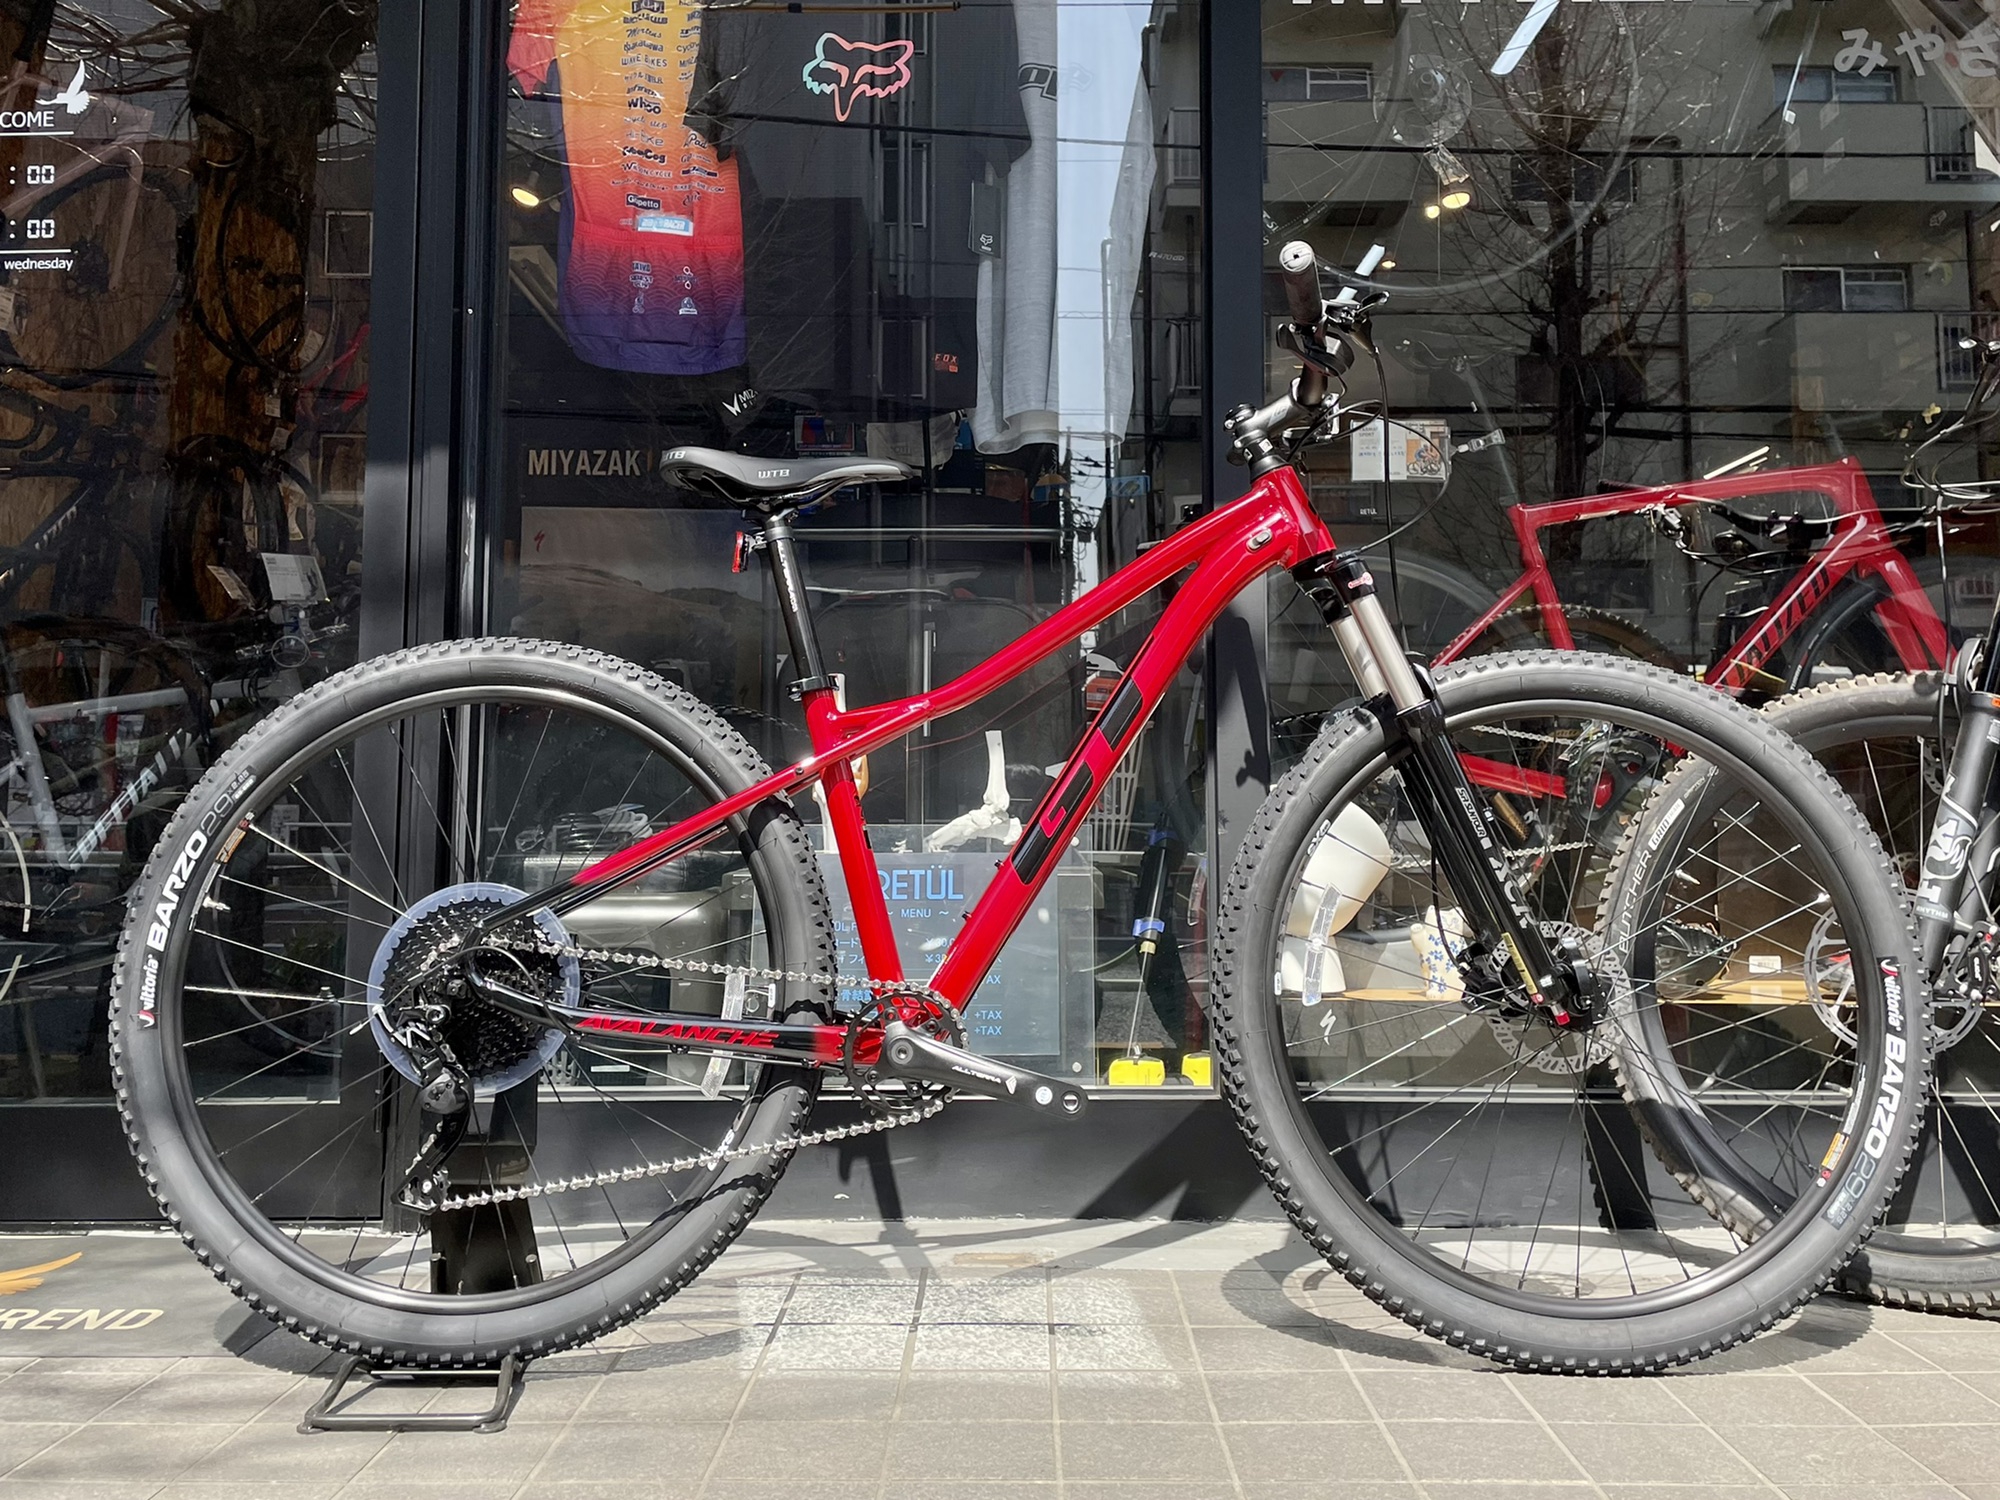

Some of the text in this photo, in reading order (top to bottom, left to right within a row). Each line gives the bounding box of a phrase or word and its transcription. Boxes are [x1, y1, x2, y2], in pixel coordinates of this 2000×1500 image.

[4, 257, 73, 271] wednesday
[758, 469, 790, 479] WTB
[147, 829, 208, 952] BARZO
[1619, 849, 1652, 955] BUTCHER
[901, 908, 932, 918] MENU
[974, 1010, 1002, 1020] +TAX
[575, 1014, 780, 1049] AVALANCHE
[974, 1026, 1002, 1035] +TAX
[1864, 1032, 1907, 1159] BARZO
